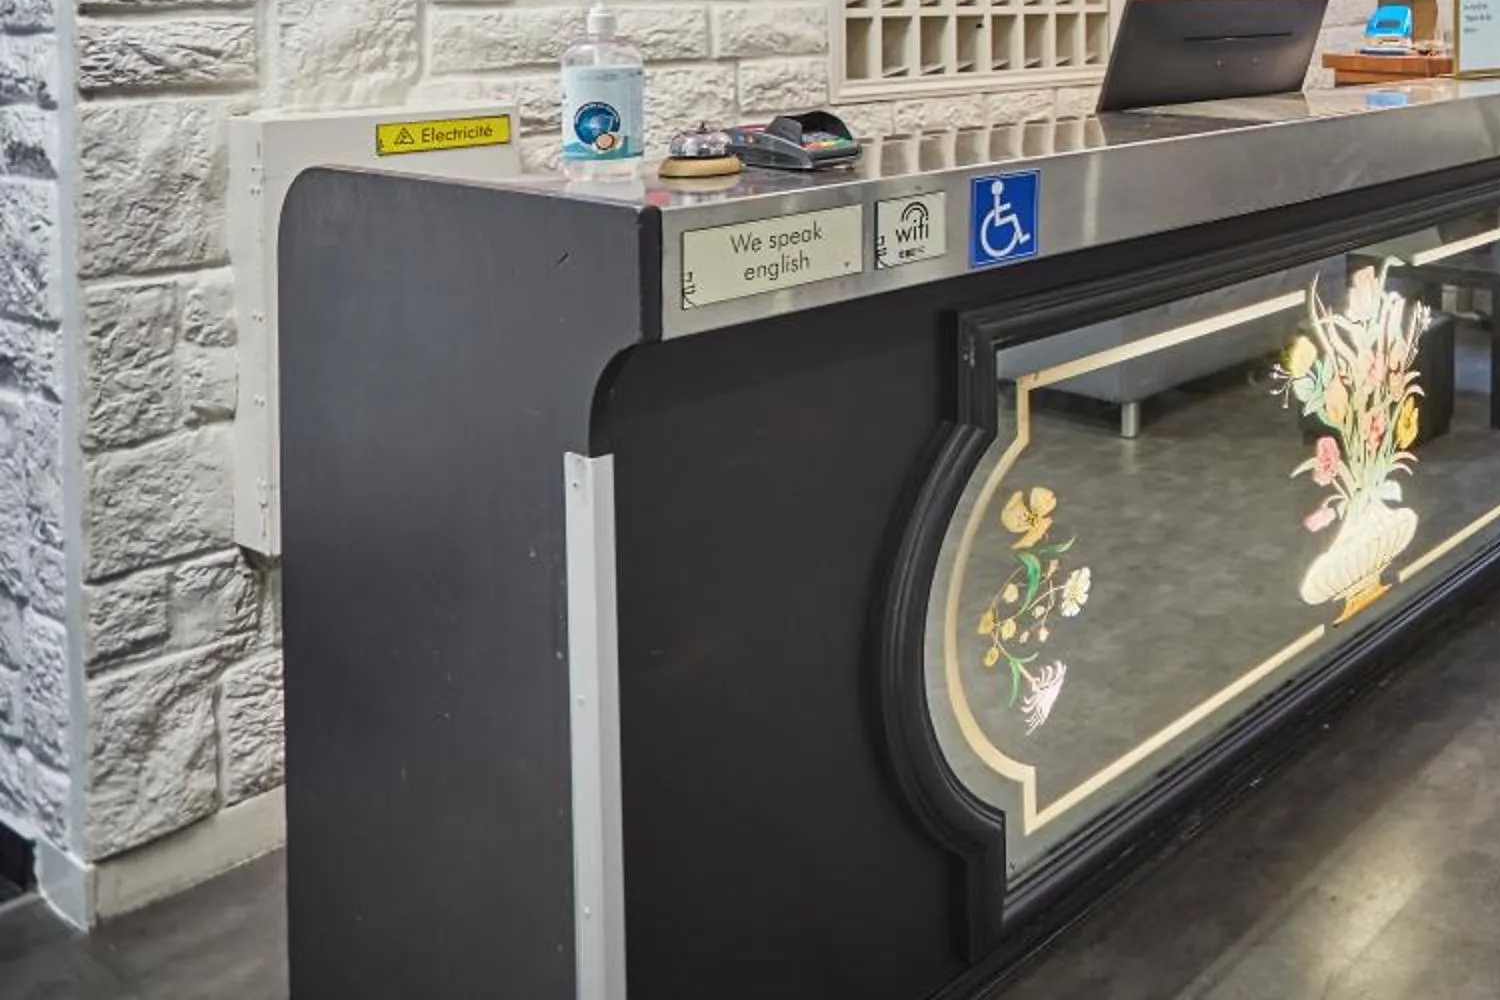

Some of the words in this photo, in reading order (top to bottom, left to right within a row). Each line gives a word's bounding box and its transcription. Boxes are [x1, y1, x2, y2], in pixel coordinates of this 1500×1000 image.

[730, 232, 762, 254] We
[769, 220, 823, 250] speak
[895, 210, 929, 243] wifi
[744, 250, 811, 281] english
